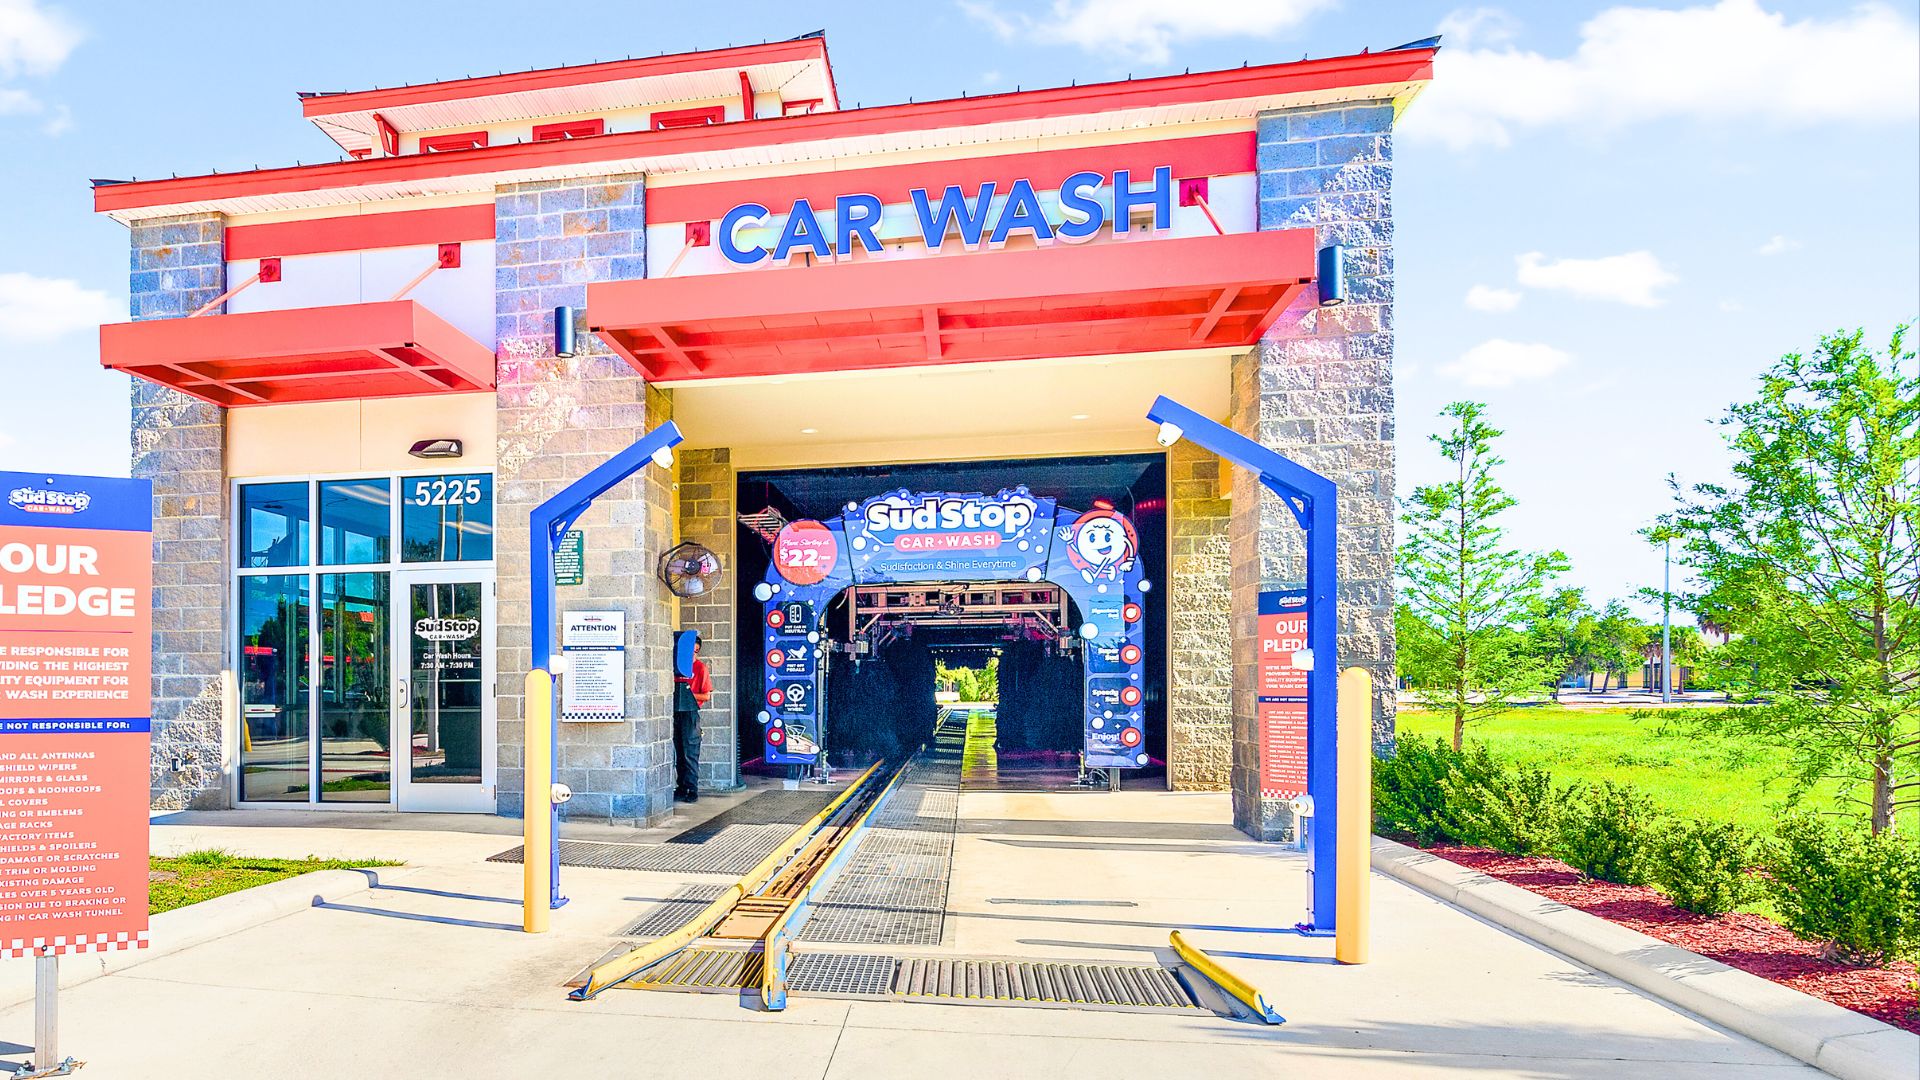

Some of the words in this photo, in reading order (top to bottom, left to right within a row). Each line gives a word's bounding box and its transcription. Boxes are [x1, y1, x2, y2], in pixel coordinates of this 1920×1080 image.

[718, 194, 886, 268] CAR
[909, 166, 1172, 251] WASH
[415, 479, 481, 506] 5225
[50, 505, 73, 513] WASH
[900, 537, 934, 548] CAR
[945, 535, 995, 547] WASH
[0, 542, 100, 575] OUR
[880, 561, 934, 572] Sudisfaction
[936, 562, 943, 570] &
[945, 560, 970, 569] Shine
[972, 559, 1017, 570] Everytime
[1276, 620, 1307, 634] OUR
[11, 647, 99, 657] RESPONSIBLE
[103, 648, 129, 657] FOR
[43, 661, 69, 671] THE
[73, 662, 129, 671] HIGHEST
[25, 675, 100, 687] EQUIPMENT
[103, 676, 129, 685] FOR
[5, 690, 48, 699] WASH
[52, 690, 129, 699] EXPERIENCE
[7, 722, 28, 730] NOT
[32, 722, 103, 730] RESPONSIBLE
[1092, 732, 1119, 742] Enjoy!
[20, 752, 38, 760] ALL
[41, 752, 95, 760] ANTENNAS
[38, 763, 77, 771] WIPERS
[56, 774, 88, 782] GLASS
[38, 785, 101, 794] MOONROOFS
[8, 798, 48, 806] COVERS
[37, 809, 83, 817] EMBLEMS
[20, 821, 53, 829] RACKS
[49, 842, 97, 850] SPOILERS
[0, 856, 43, 864] DAMAGE
[63, 852, 120, 861] SCRATCHES
[5, 867, 30, 875] TRIM
[50, 865, 96, 873] MOLDING
[42, 877, 84, 885] DAMAGE
[59, 887, 92, 895] YEARS
[95, 886, 115, 894] OLD
[25, 901, 46, 909] DUE
[65, 898, 109, 907] BRAKING
[14, 913, 25, 921] IN
[28, 912, 49, 920] CAR
[52, 911, 82, 919] WASH
[85, 908, 124, 917] TUNNEL
